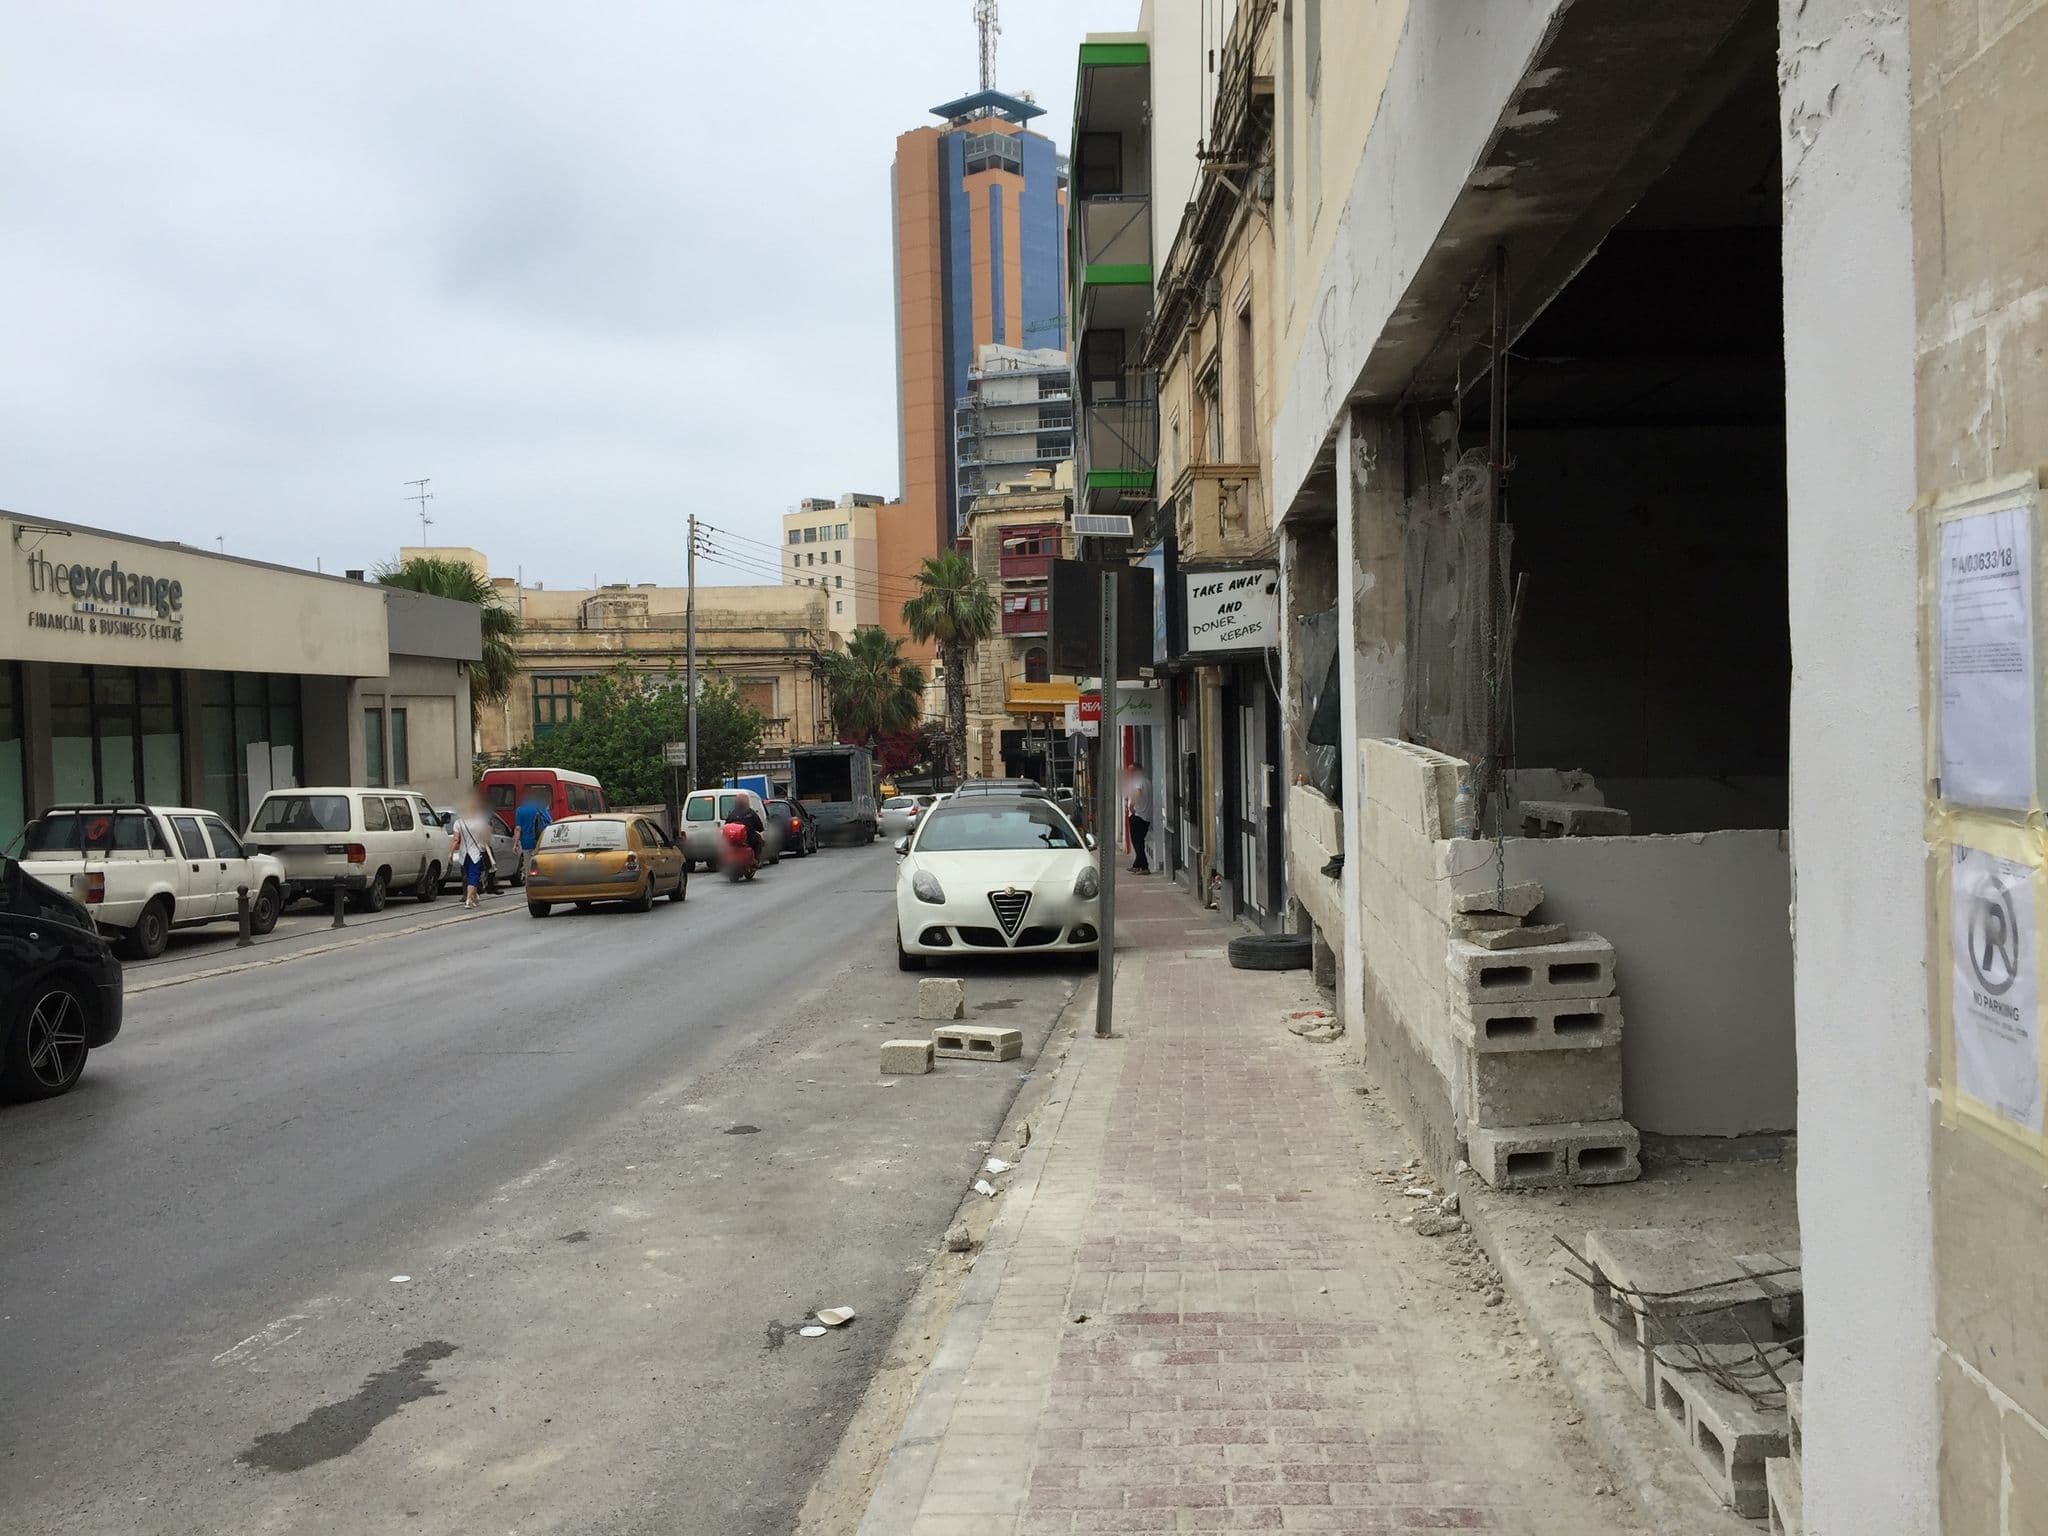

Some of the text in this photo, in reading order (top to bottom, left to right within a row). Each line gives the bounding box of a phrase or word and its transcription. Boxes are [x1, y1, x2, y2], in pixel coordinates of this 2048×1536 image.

[1192, 573, 1263, 598] TAKE AWAY
[1217, 600, 1243, 615] AND
[28, 611, 184, 642] FINANCIAL & BUSINESS CENTRE
[1192, 615, 1237, 635] DONER
[1220, 621, 1263, 642] KEBABS
[1983, 995, 2020, 1021] PARKING
